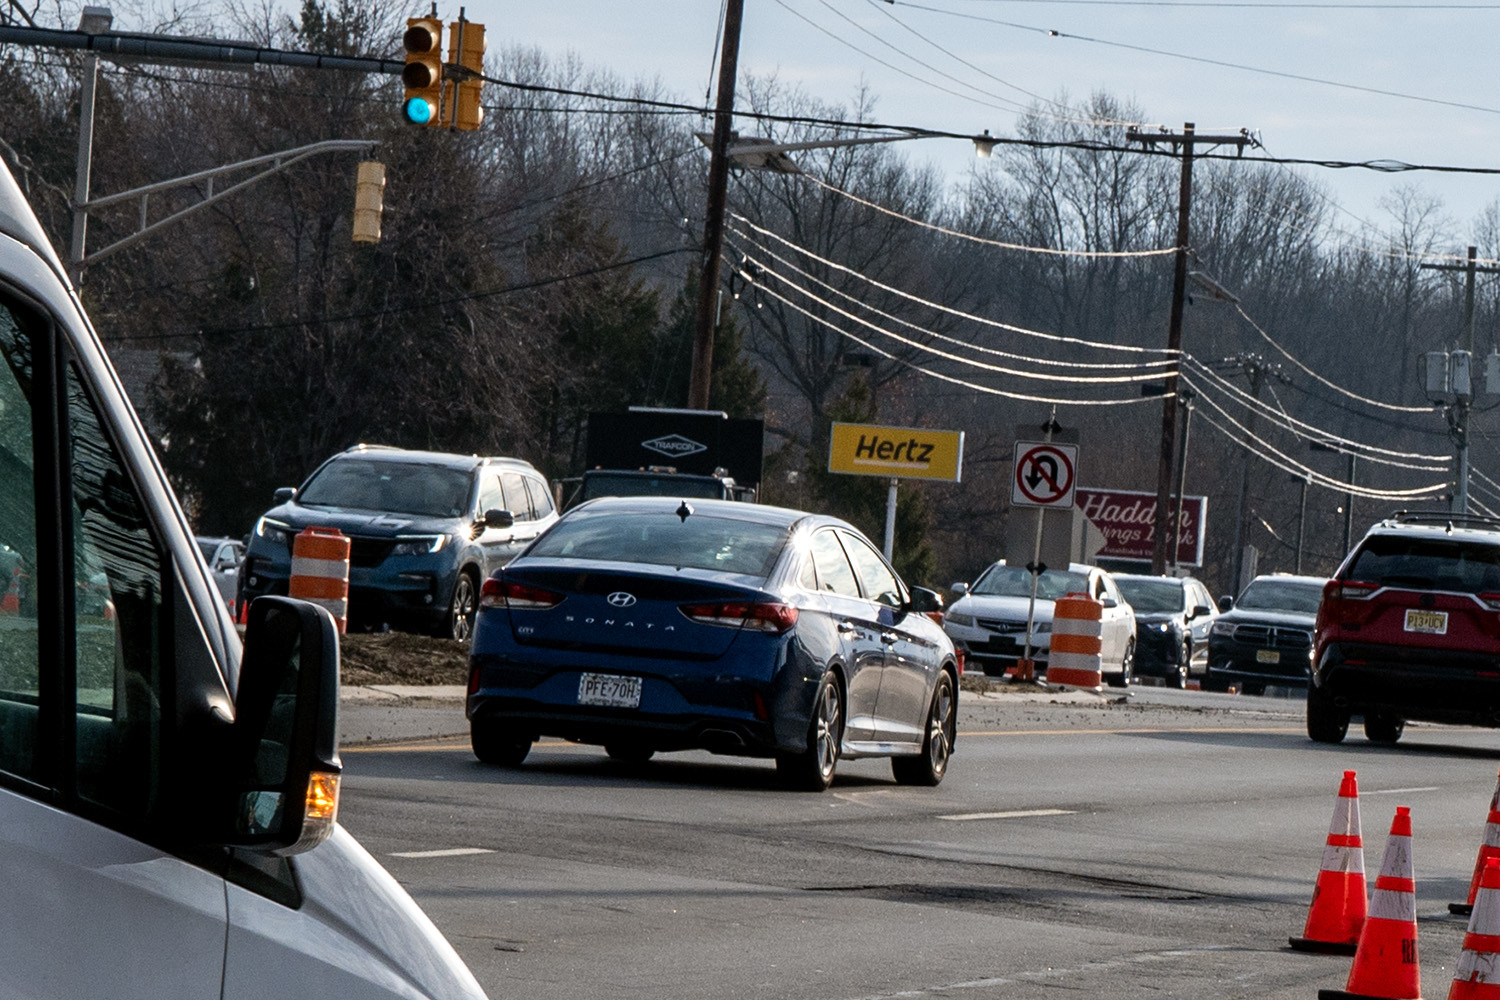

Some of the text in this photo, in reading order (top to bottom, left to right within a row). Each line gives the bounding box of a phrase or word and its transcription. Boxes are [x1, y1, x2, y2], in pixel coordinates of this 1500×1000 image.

[855, 434, 935, 463] Hertz
[1083, 494, 1192, 528] Haddn
[566, 615, 675, 631] SONATA
